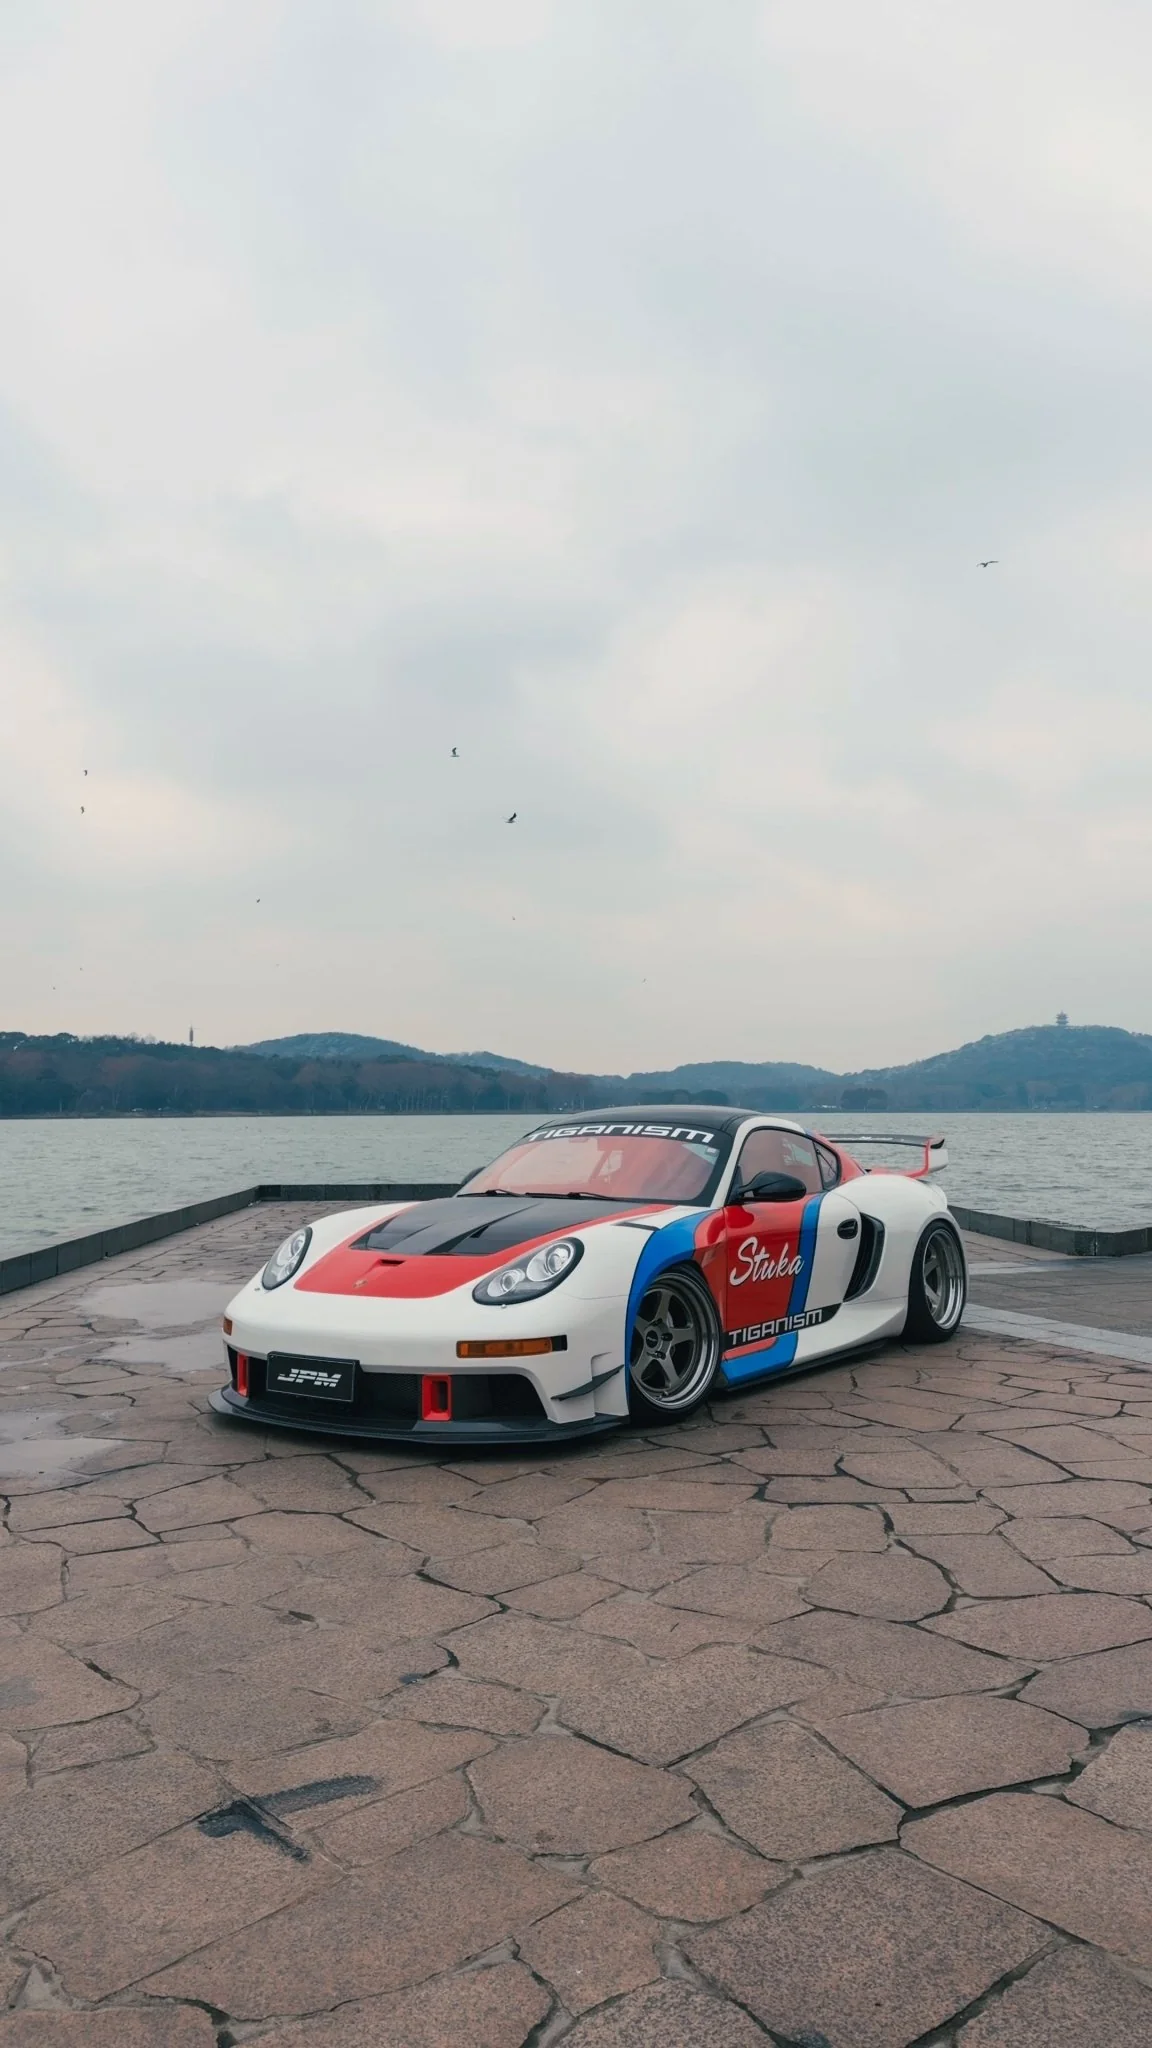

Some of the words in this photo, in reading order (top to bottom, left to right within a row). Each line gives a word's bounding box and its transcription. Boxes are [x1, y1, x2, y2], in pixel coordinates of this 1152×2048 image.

[528, 1124, 715, 1143] TIGANISM
[729, 1236, 805, 1286] Stuka
[729, 1309, 822, 1345] TIGANISM
